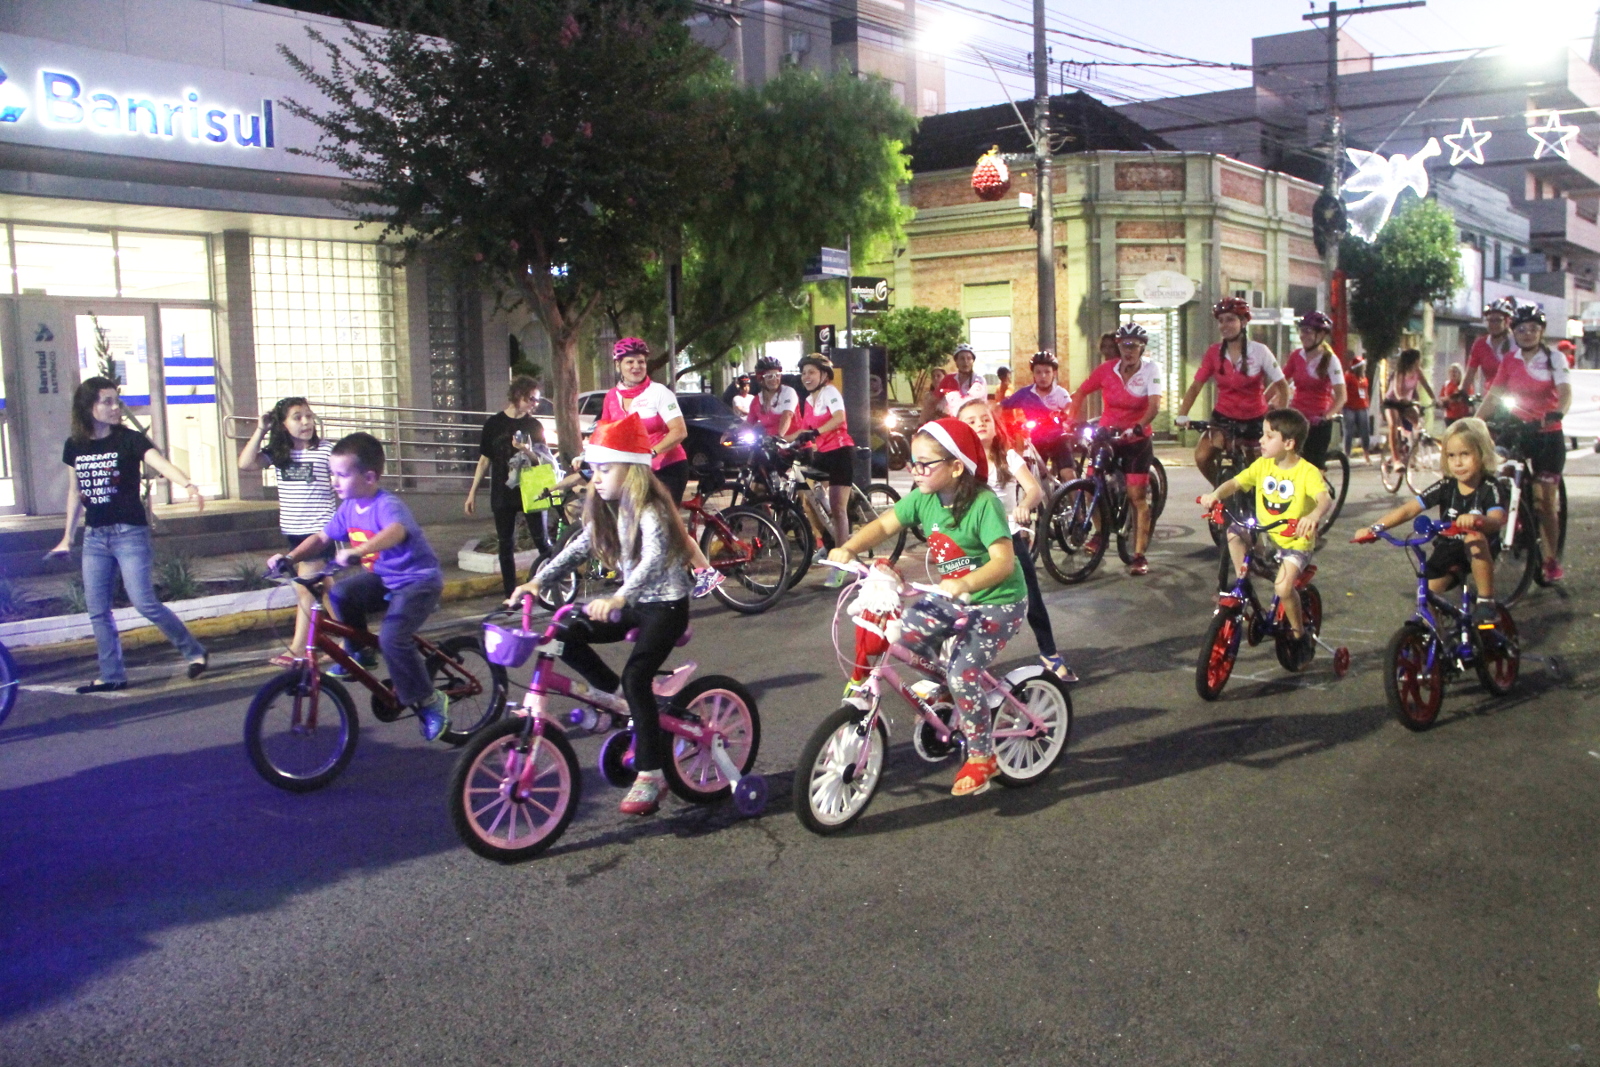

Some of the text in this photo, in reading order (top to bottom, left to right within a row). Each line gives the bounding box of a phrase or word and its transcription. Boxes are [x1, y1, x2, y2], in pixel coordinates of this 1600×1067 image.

[41, 70, 275, 148] Banrisul
[80, 478, 110, 487] TO LIVE
[92, 487, 118, 496] YOUNG
